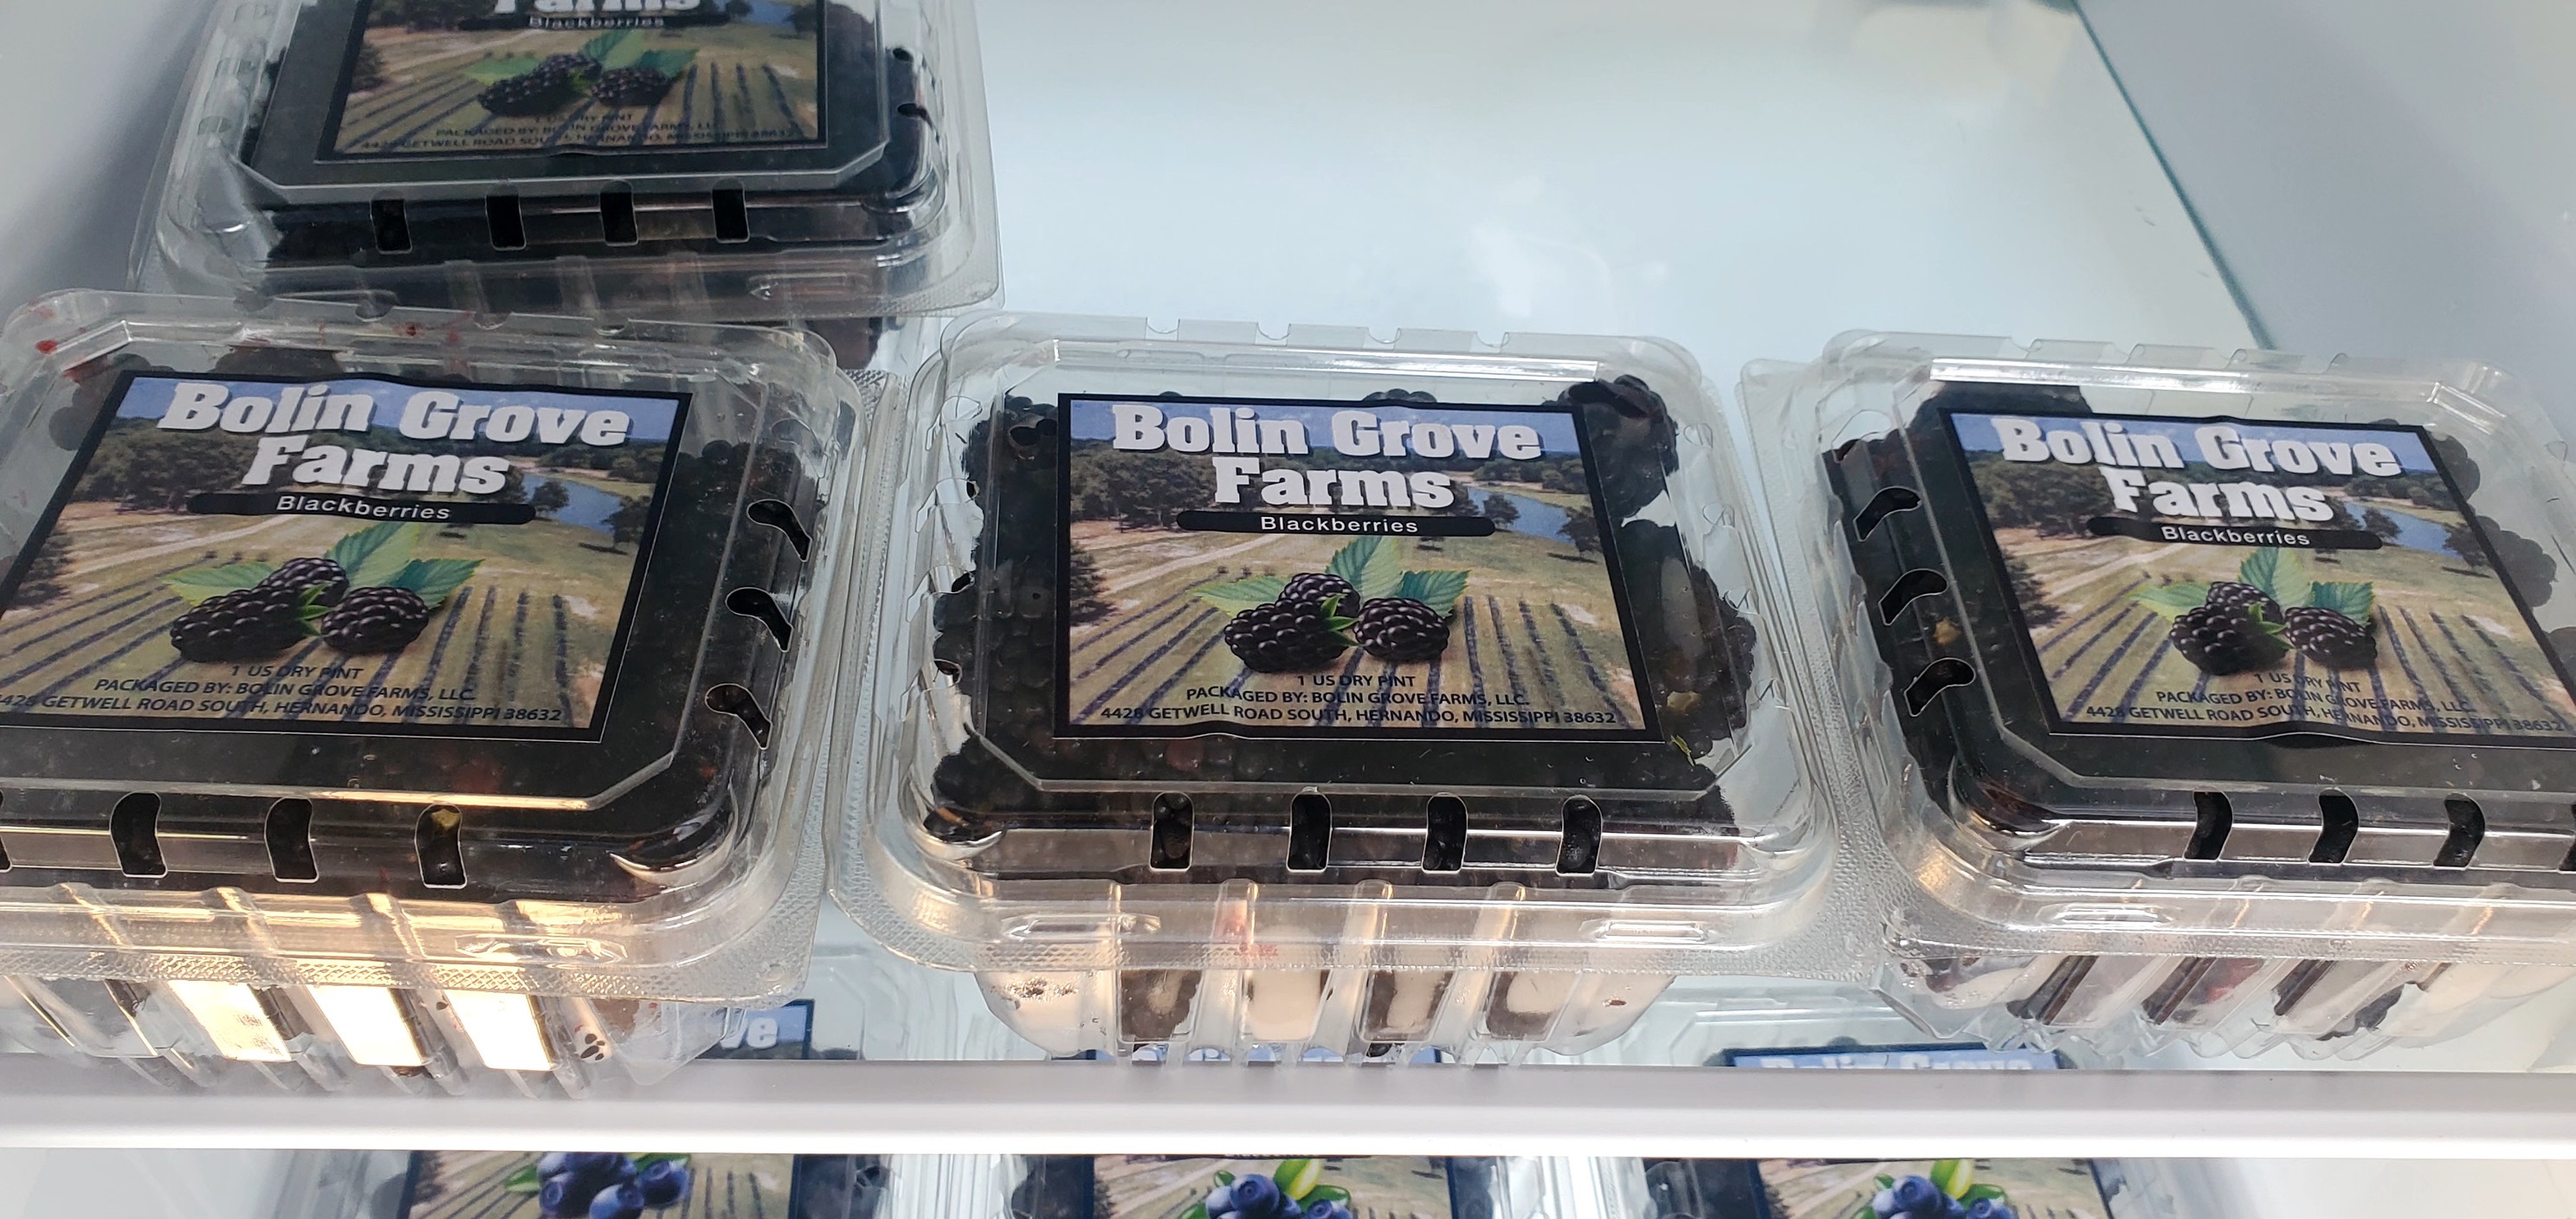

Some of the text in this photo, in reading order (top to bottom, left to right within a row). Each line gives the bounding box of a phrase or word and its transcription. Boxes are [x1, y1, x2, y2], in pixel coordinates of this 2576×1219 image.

[528, 16, 665, 29] Blackberries
[157, 382, 631, 446] Bolin Grove
[1113, 403, 1542, 460] Bolin Grove
[1992, 417, 2402, 477] Bolin Grove
[242, 435, 511, 494] Farms
[1214, 456, 1455, 508] Farms
[2099, 466, 2335, 521] Farms
[276, 495, 451, 519] Blackberries
[1261, 515, 1418, 533] Blackberries
[2160, 525, 2310, 546] Blackberries
[248, 666, 271, 677] US
[276, 666, 315, 678] DRY
[319, 668, 364, 680] PINT
[1314, 675, 1335, 686] US
[1339, 674, 1372, 687] DRY
[1378, 675, 1416, 687] PINT
[2269, 673, 2291, 684] US
[94, 679, 199, 694] PACKAGED
[203, 681, 232, 694] BY:
[236, 682, 294, 695] BOLIN
[298, 684, 365, 698] GROVE
[367, 687, 434, 701] FARMS,
[1187, 686, 1529, 706] PACKAGED BY: BOLIN GROVE FARMS, LLC.
[2156, 691, 2242, 705] PACKAGED
[2247, 689, 2273, 702] BY:
[0, 694, 562, 721] 428 GETWELL ROAD SOUTH, HERNANDO, MISSISSIPPI 38632
[1101, 703, 1616, 724] 4428 GETWELL ROAD SOUTH, HERNANDO, MISSISSIPPI 38632
[2086, 706, 2126, 719] 4428
[2129, 706, 2205, 720] GETWELL
[2207, 709, 2253, 722] ROAD
[2515, 719, 2566, 732] 38632
